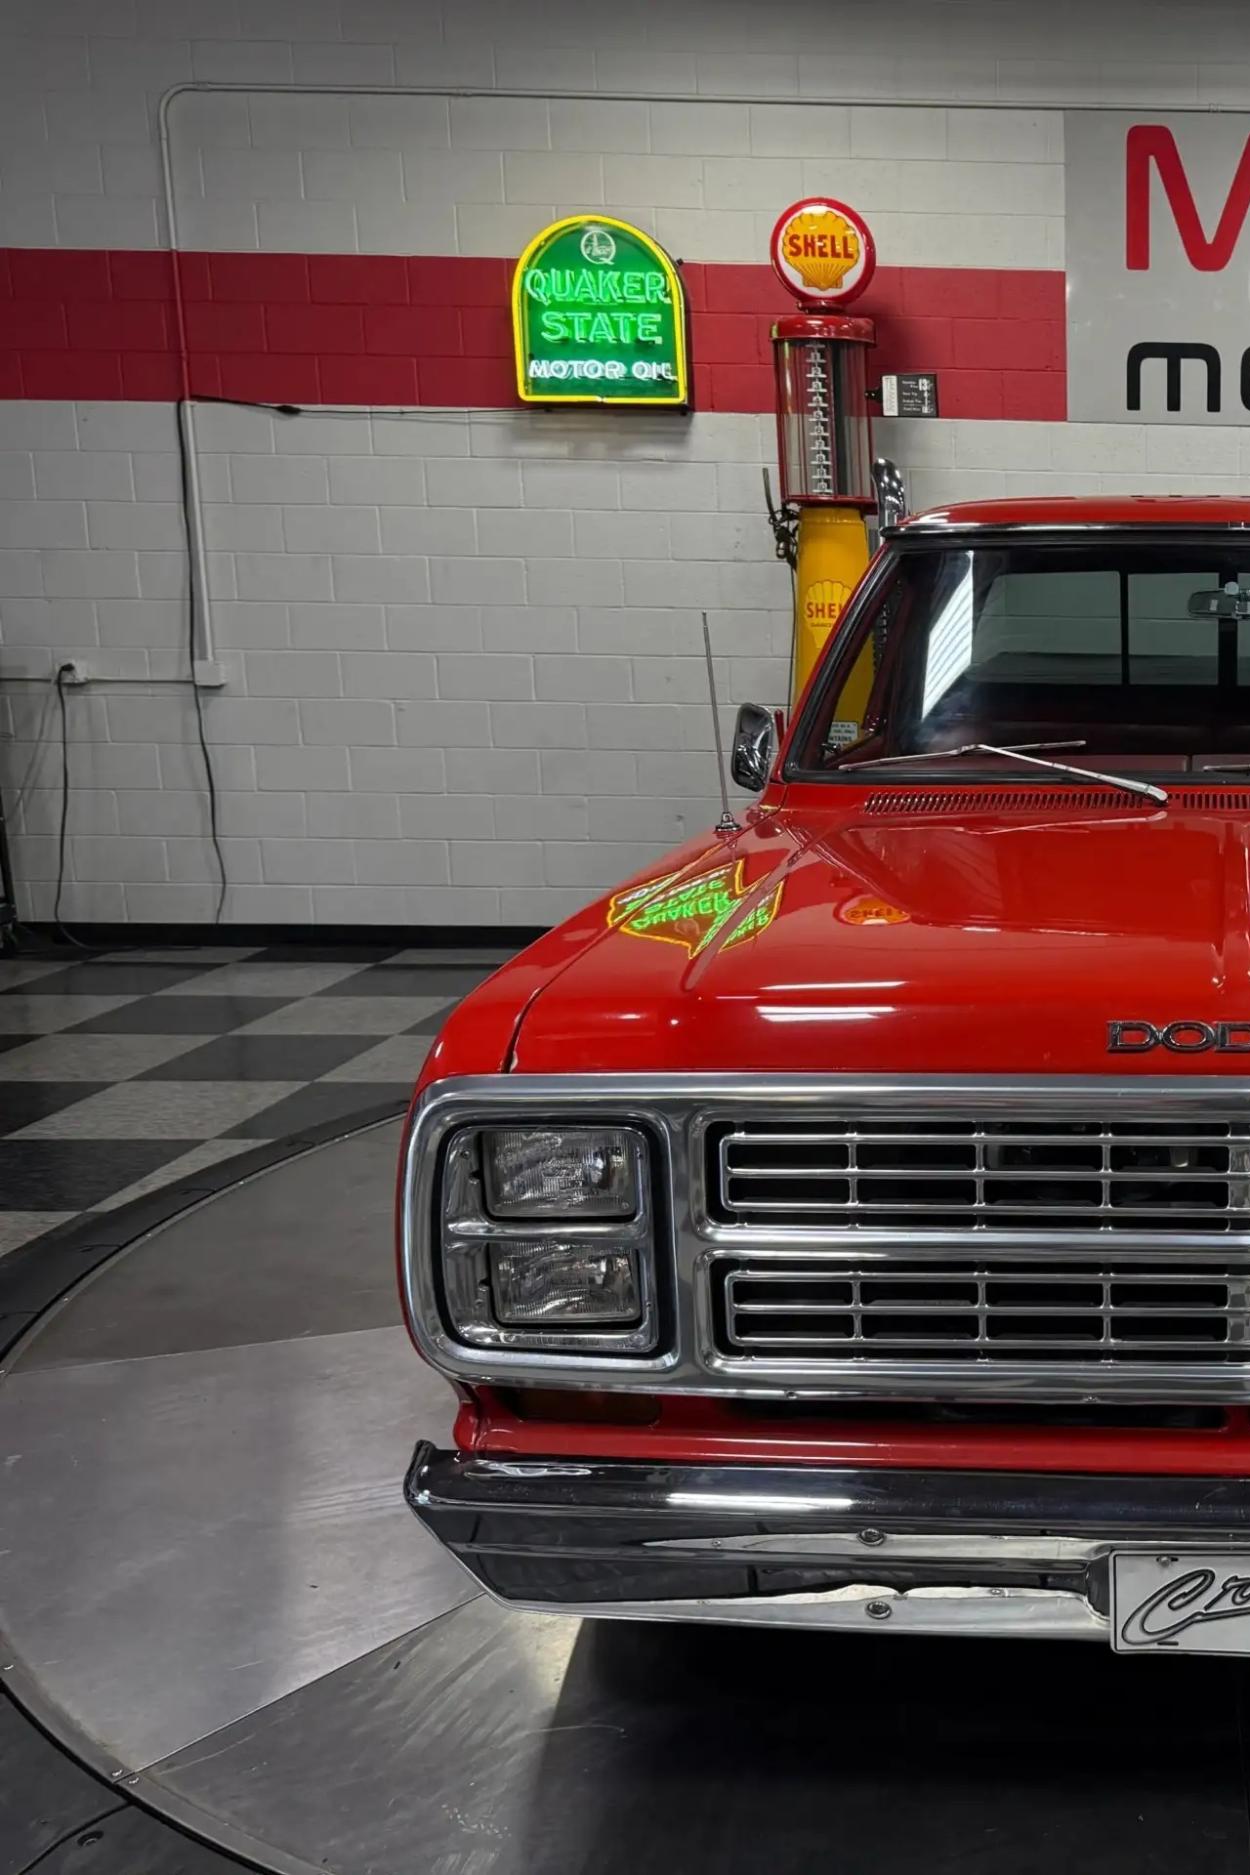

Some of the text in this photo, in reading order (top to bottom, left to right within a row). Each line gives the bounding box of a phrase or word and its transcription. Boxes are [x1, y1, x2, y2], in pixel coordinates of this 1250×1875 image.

[788, 234, 854, 259] SHELL
[525, 268, 672, 306] QUAKER
[541, 311, 663, 344] STATE
[528, 359, 678, 381] MOTOR OIL
[806, 602, 843, 619] SHE
